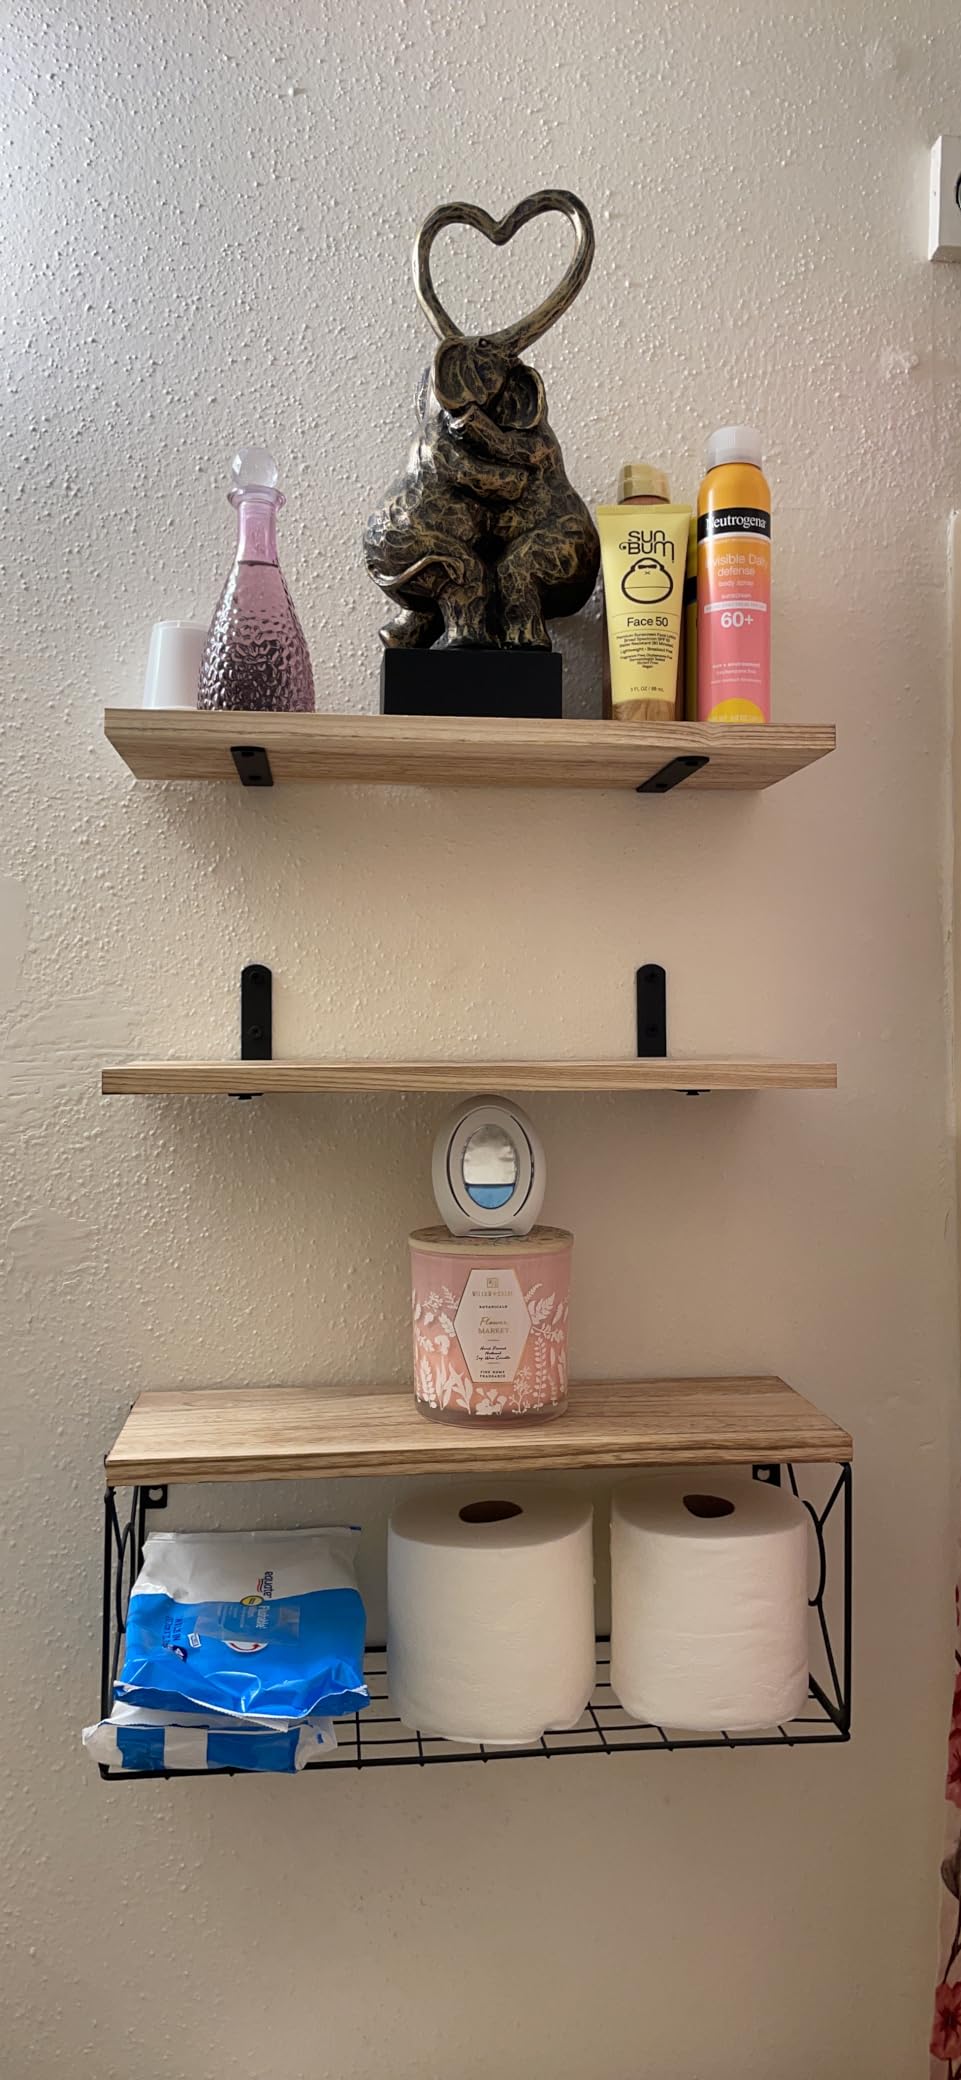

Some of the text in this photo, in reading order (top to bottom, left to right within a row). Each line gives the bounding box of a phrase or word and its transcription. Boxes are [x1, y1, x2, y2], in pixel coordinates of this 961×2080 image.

[705, 515, 767, 529] Neutrogena
[718, 567, 755, 577] defense
[627, 616, 668, 628] Face 50
[720, 611, 754, 629] 60+
[263, 1571, 273, 1596] equate
